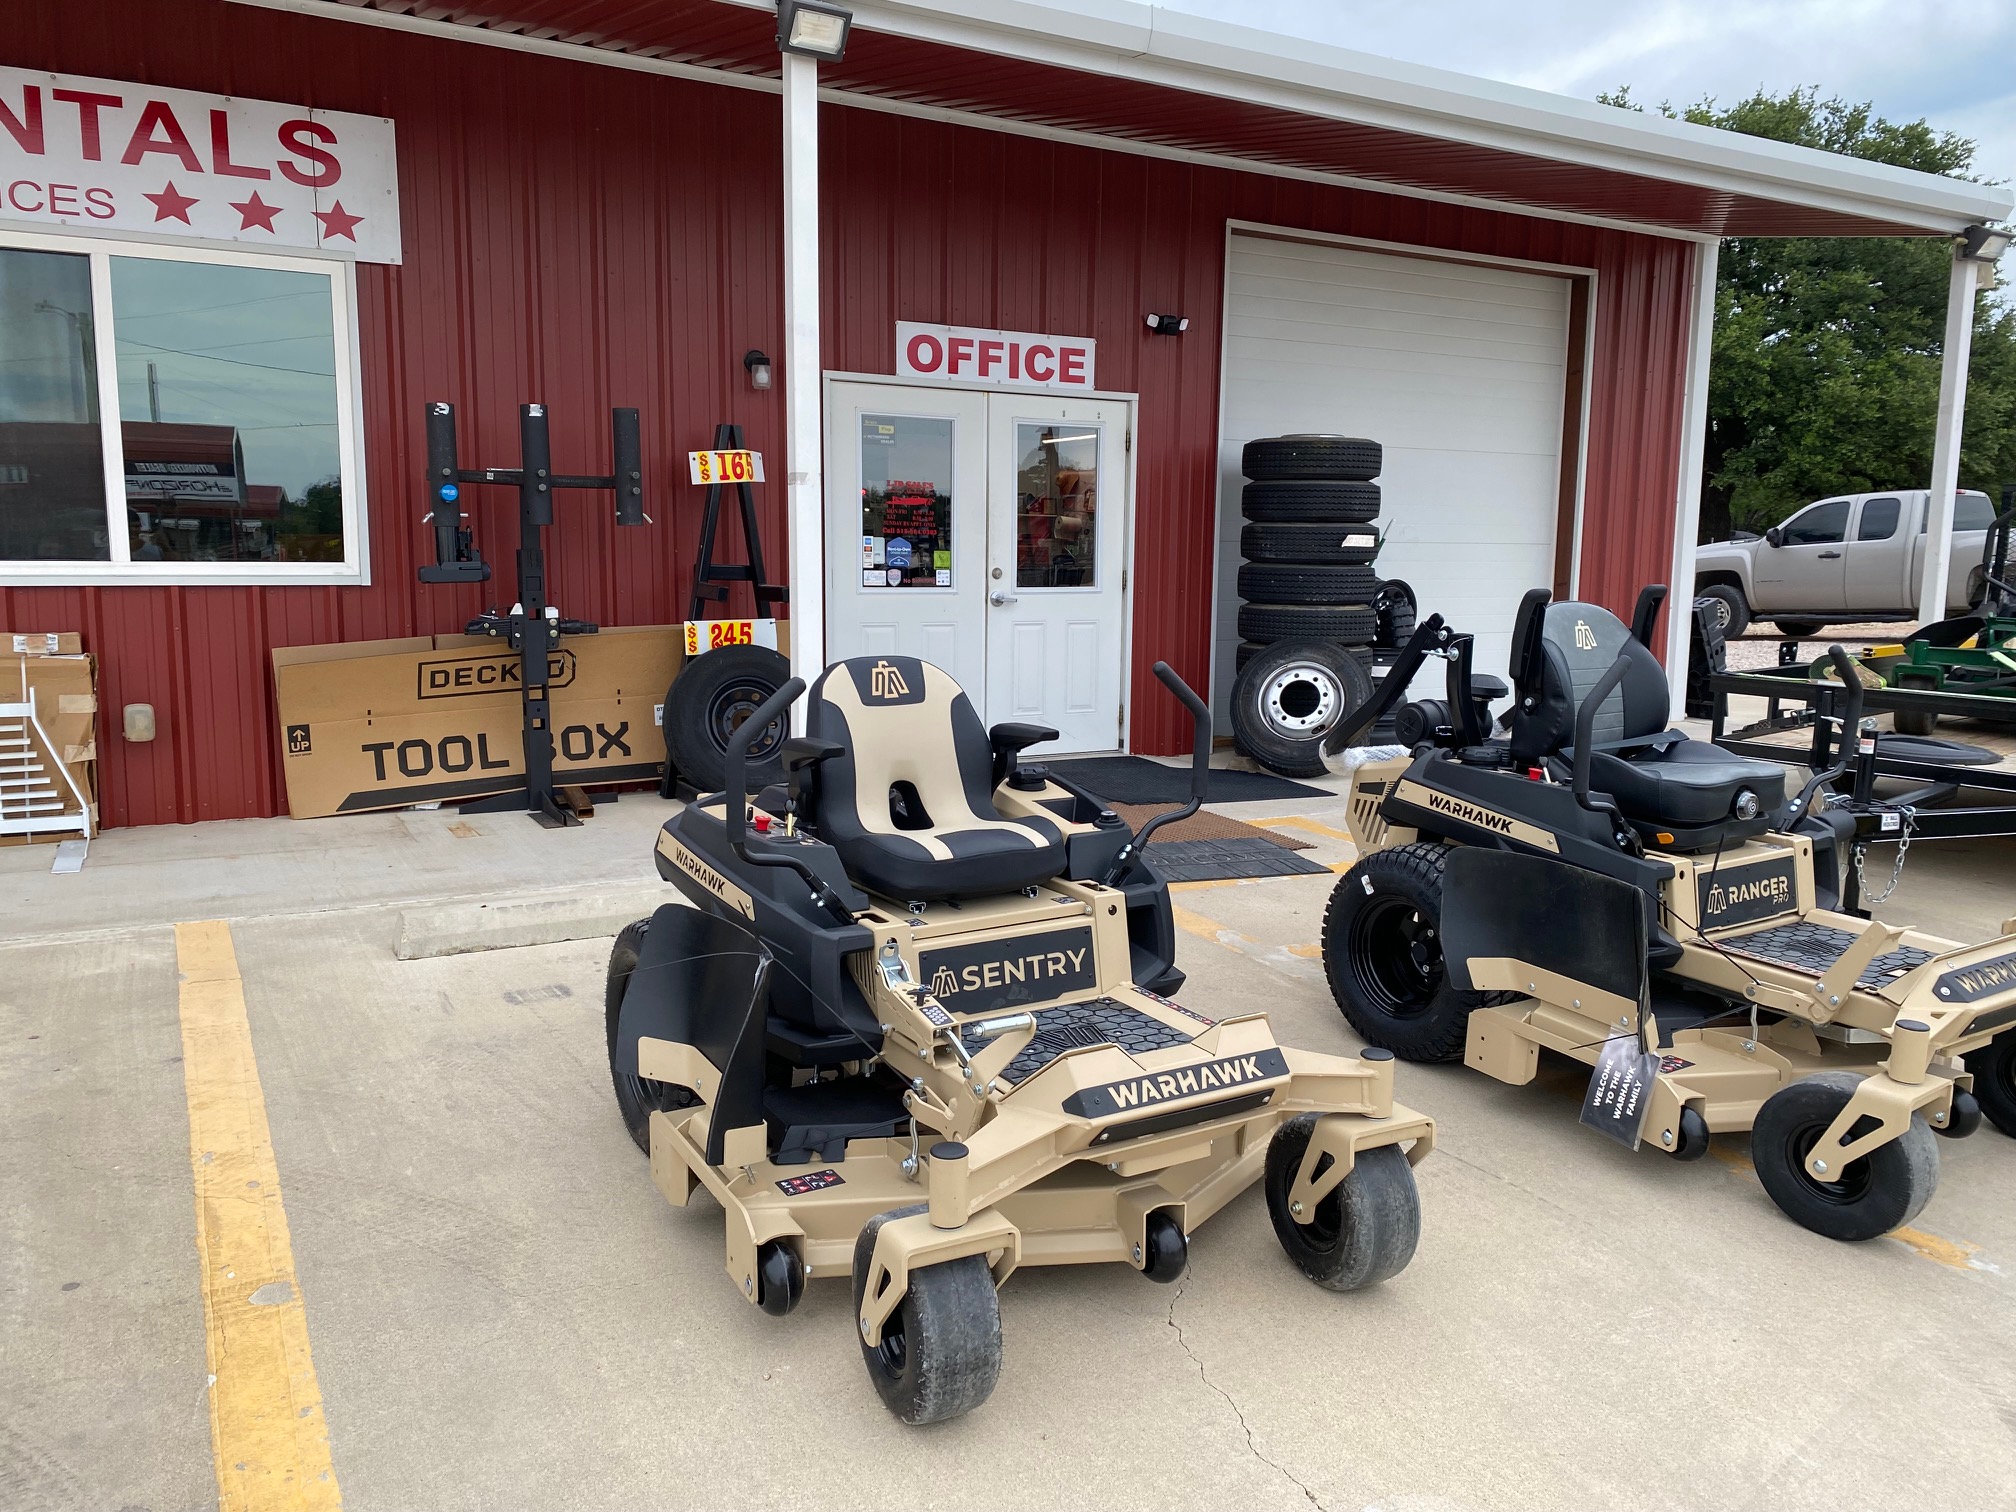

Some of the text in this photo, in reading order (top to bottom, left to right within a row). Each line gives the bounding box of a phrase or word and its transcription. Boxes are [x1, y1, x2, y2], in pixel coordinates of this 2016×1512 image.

[0, 179, 116, 219] CES
[906, 334, 1086, 384] OFFICE
[699, 454, 709, 467] $
[701, 467, 711, 481] $
[717, 452, 754, 481] 165
[905, 480, 934, 489] SALES
[687, 625, 696, 639] $
[689, 640, 698, 653] $
[710, 622, 752, 649] 245
[429, 659, 566, 689] DECKD
[290, 741, 310, 751] UP
[361, 721, 632, 781] TOOL OX
[1429, 793, 1514, 833] WARHAWK
[675, 847, 726, 895] WARHAWK
[1728, 875, 1789, 905] RANGER
[1772, 893, 1790, 905] PRO
[961, 947, 1087, 991] SENTRY
[1107, 1055, 1265, 1108] WARHAWK
[1592, 1058, 1615, 1107] WELCOME
[1605, 1070, 1622, 1105] TO THE
[1613, 1066, 1637, 1119] WARHAWK
[1626, 1080, 1643, 1116] FAMILY
